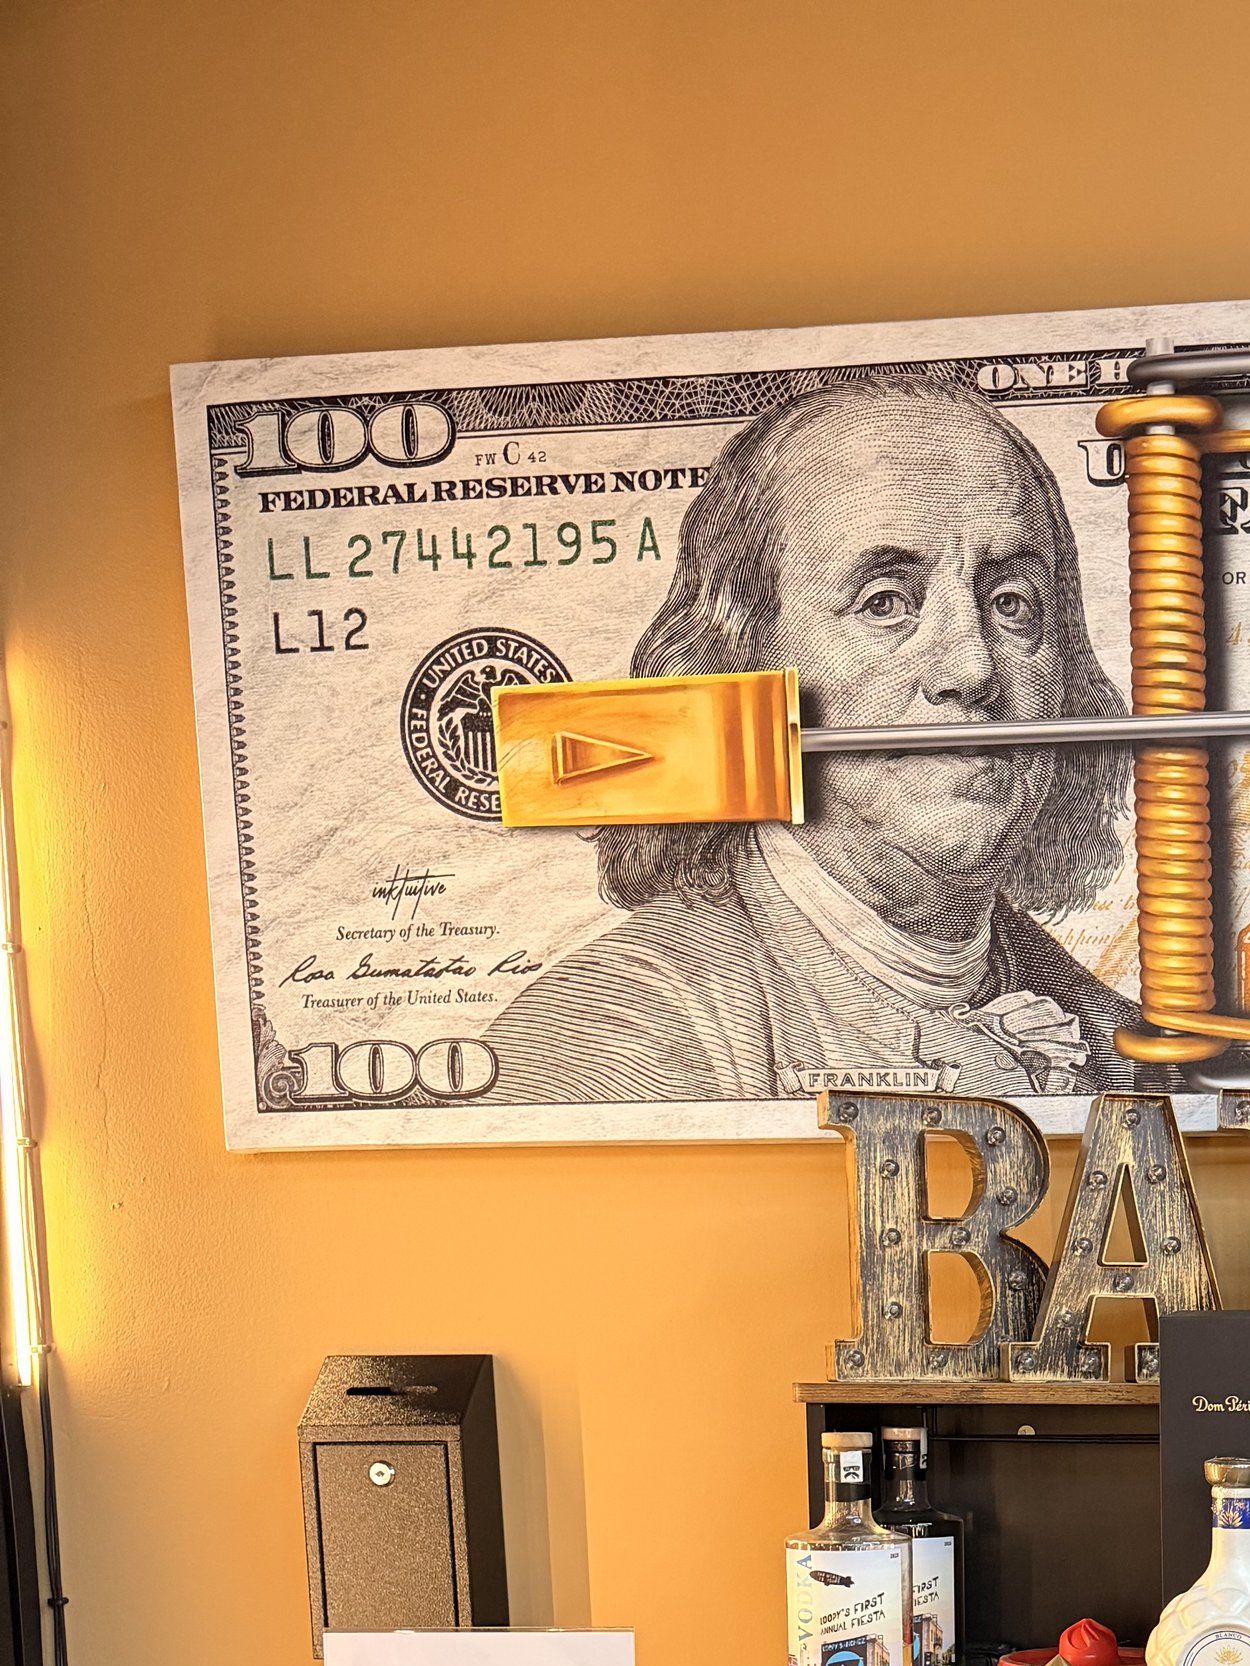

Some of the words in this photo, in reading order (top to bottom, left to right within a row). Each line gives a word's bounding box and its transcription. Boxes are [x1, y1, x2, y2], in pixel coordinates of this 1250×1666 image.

[976, 359, 1090, 397] ONE
[234, 402, 458, 478] 100
[475, 452, 497, 467] FW
[502, 440, 522, 466] C
[527, 449, 547, 464] 42
[258, 481, 428, 513] FEDERAL
[430, 472, 612, 502] RESERVE
[609, 466, 712, 493] NOTE
[267, 534, 330, 581] LL
[347, 518, 618, 578] 27442195
[636, 516, 662, 562] A
[272, 606, 370, 655] L12
[422, 638, 490, 691] UNITED
[495, 638, 556, 684] STATES
[409, 706, 452, 794] FEDERAL
[335, 924, 397, 943] Secretary
[399, 924, 413, 940] of
[415, 923, 436, 939] the
[437, 921, 501, 941] Treasury.
[301, 992, 365, 1011] Treasurer
[367, 990, 384, 1007] of
[384, 991, 406, 1007] the
[407, 989, 453, 1006] United
[454, 988, 499, 1005] States.
[286, 1036, 501, 1103] 100
[807, 1067, 933, 1090] FRANKLIN
[1191, 1395, 1225, 1414] Dom
[796, 1553, 815, 1642] VODKA
[853, 1591, 886, 1616] FIRST
[819, 1621, 848, 1637] ANNUAL
[850, 1608, 886, 1629] FIESTA
